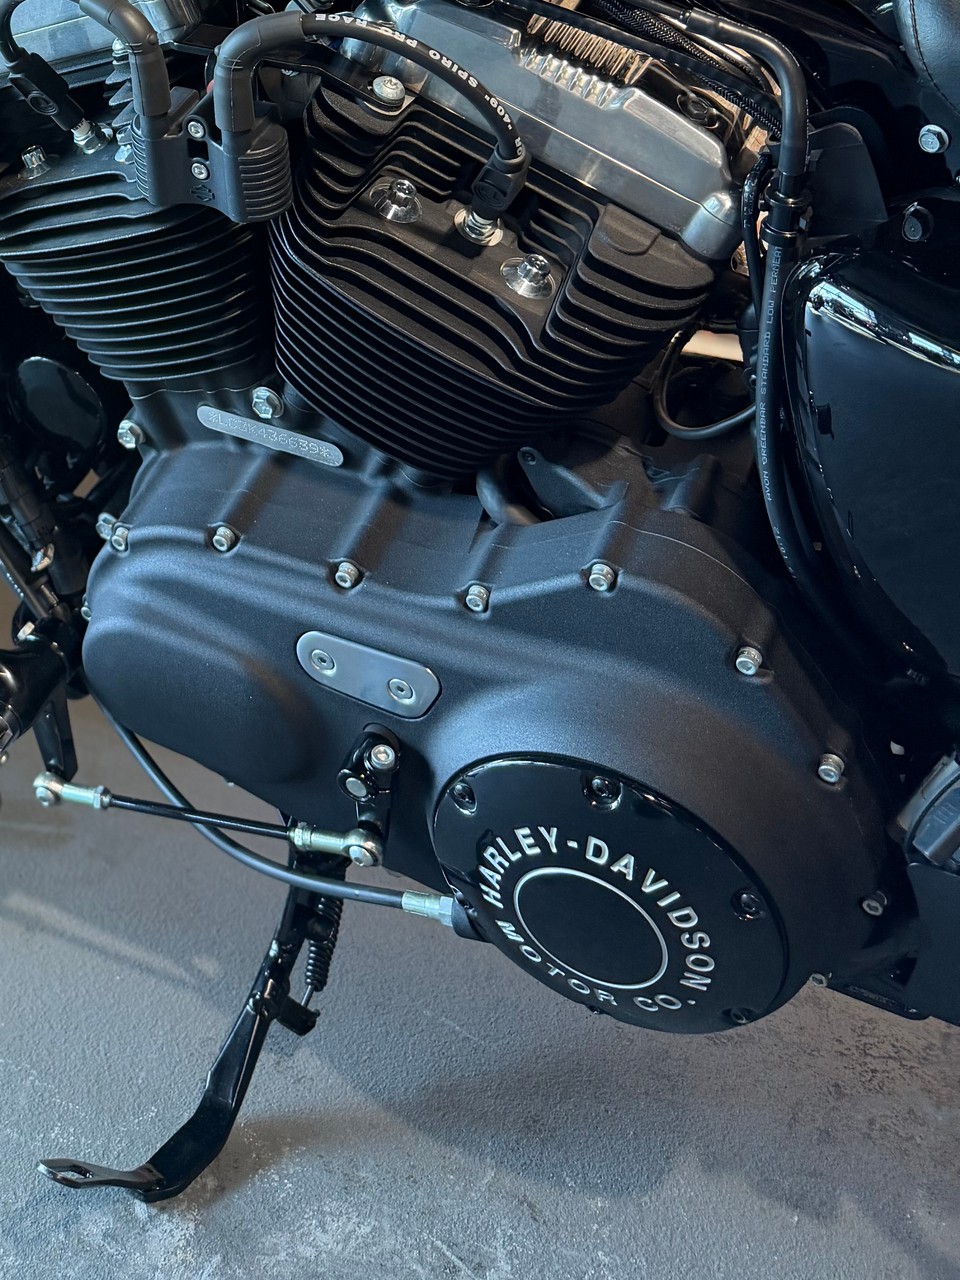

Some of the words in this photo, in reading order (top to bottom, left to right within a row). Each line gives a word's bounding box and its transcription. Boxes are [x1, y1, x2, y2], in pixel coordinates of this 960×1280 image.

[315, 13, 368, 28] RACE
[428, 49, 479, 88] SPIRO
[766, 300, 775, 324] LOW
[760, 331, 771, 395] STANDARD
[762, 471, 773, 501] AVON
[478, 825, 716, 992] HARLEY-DAVIDSON
[494, 919, 618, 1007] MOTOR
